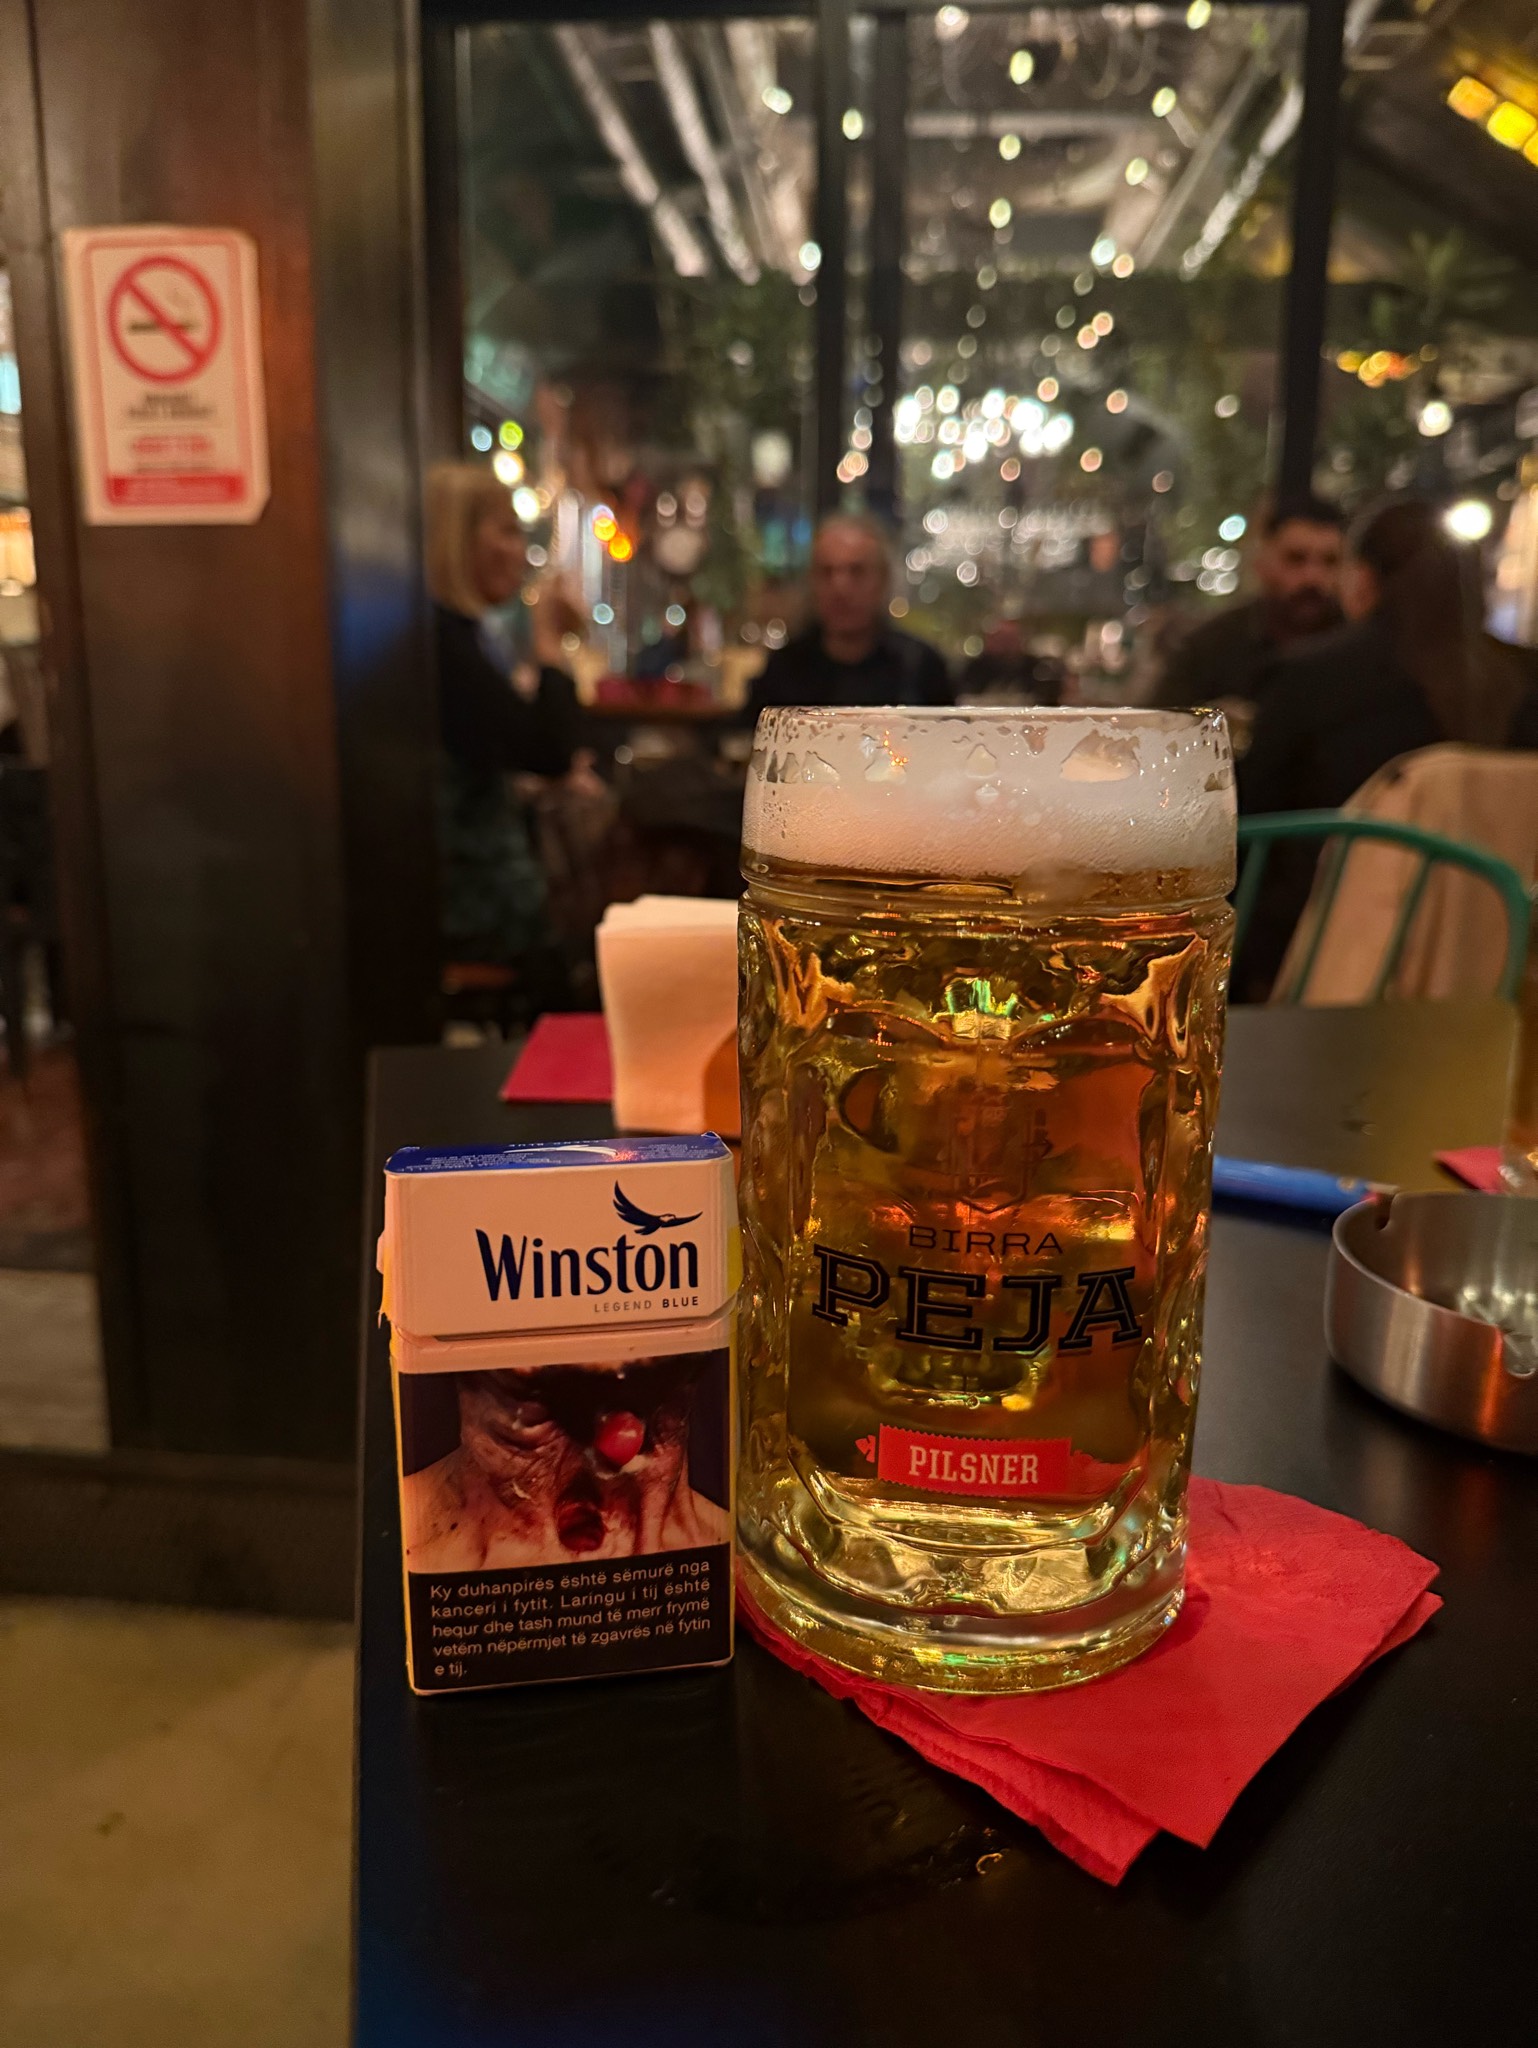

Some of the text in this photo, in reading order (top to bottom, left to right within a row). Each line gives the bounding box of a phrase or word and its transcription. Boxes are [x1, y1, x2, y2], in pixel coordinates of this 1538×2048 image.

[909, 1225, 1063, 1255] BIRRA
[475, 1228, 699, 1301] Winston
[594, 1296, 699, 1314] LEGEND BLUE
[812, 1244, 1142, 1351] PEJA
[908, 1445, 1039, 1485] PILSNER
[430, 1561, 710, 1601] Ky duhanpirës është sëmurë nga
[431, 1601, 496, 1618] kanceri
[561, 1591, 625, 1608] Laringu
[643, 1584, 658, 1600] tij
[664, 1578, 710, 1596] është
[432, 1597, 710, 1639] hequr dhe tash mund të merr frymë
[434, 1617, 711, 1656] vetëm nëpërmjet të zgavrës në fytin
[434, 1661, 467, 1677] e tij.
